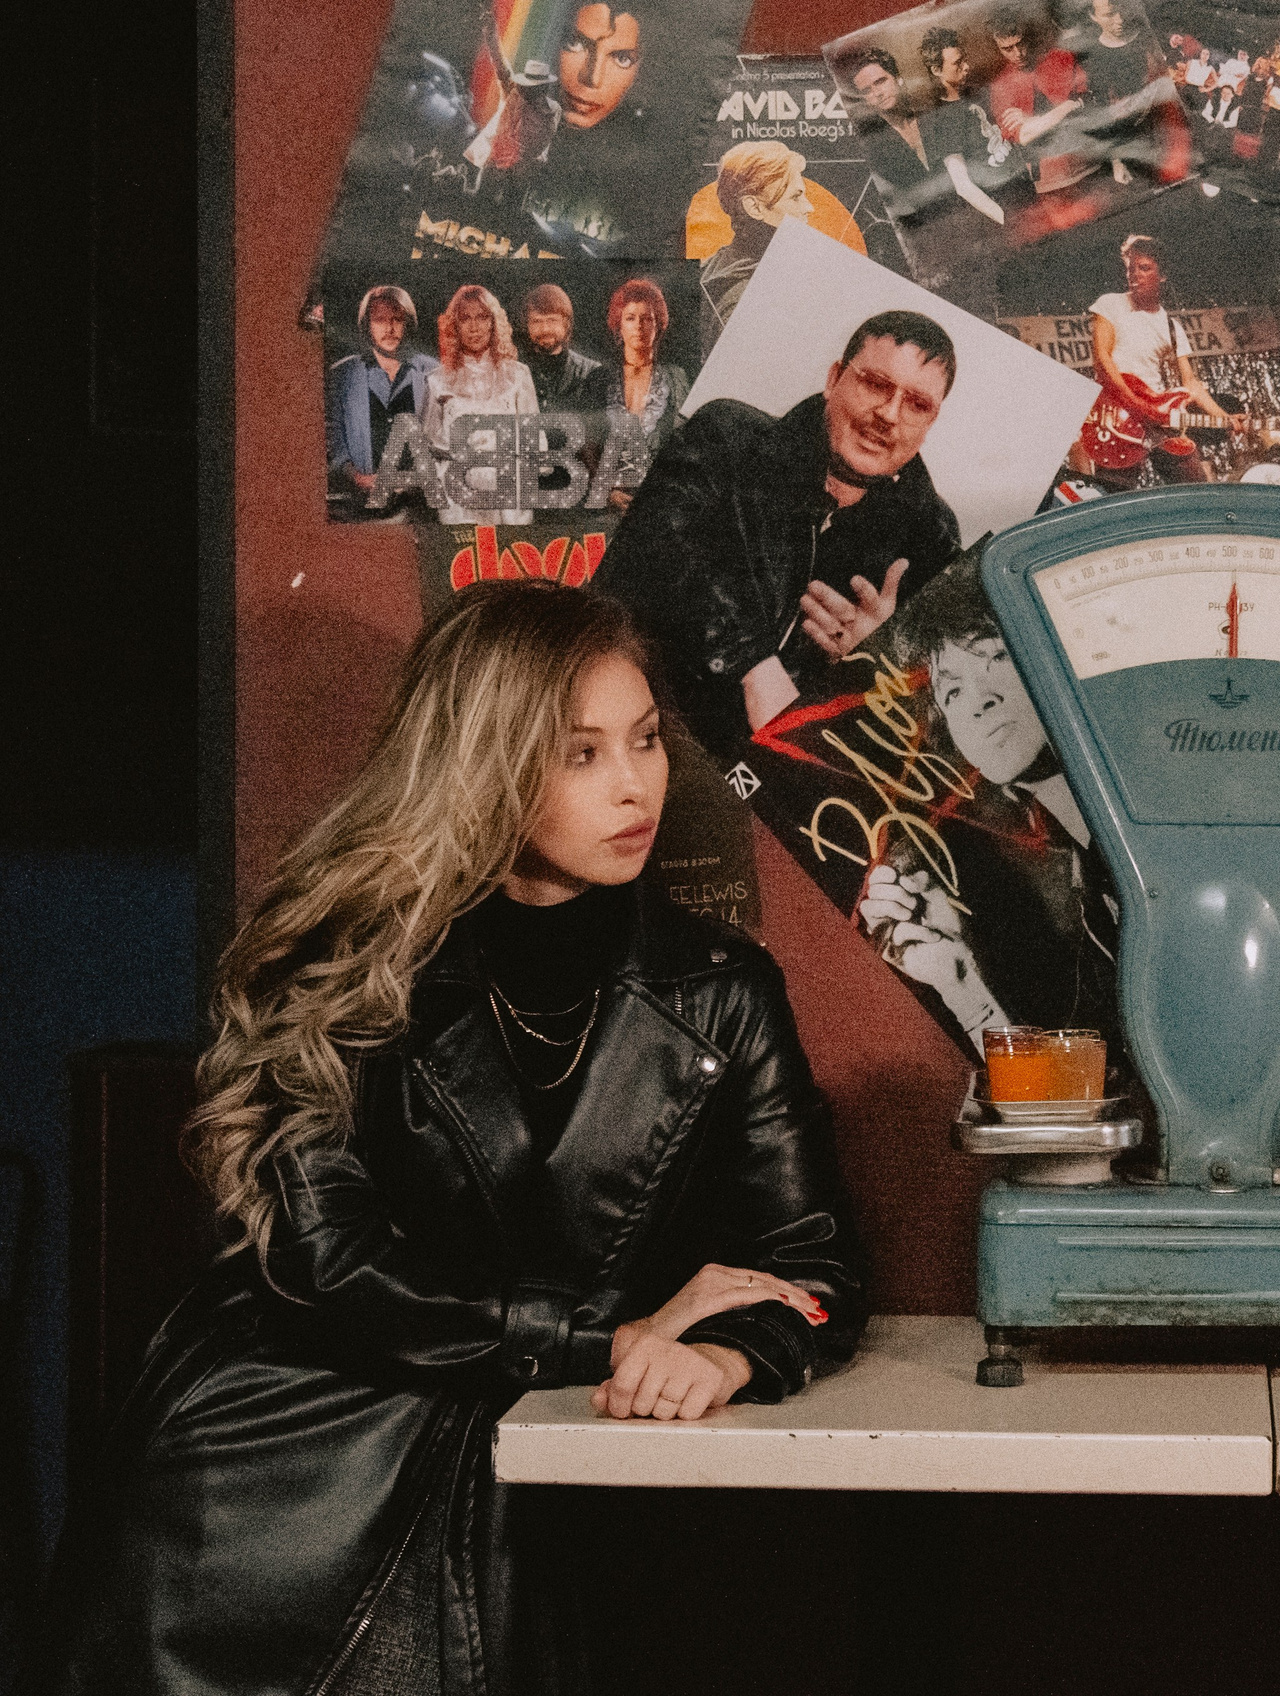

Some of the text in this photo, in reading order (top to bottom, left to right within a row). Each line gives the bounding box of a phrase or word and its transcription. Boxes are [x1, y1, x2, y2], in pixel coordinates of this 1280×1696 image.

[732, 125, 744, 139] in
[747, 122, 796, 138] Nicolas
[799, 121, 845, 142] Roeg's
[1185, 546, 1201, 558] 400
[1222, 545, 1238, 557] 500
[1259, 547, 1275, 560] 600
